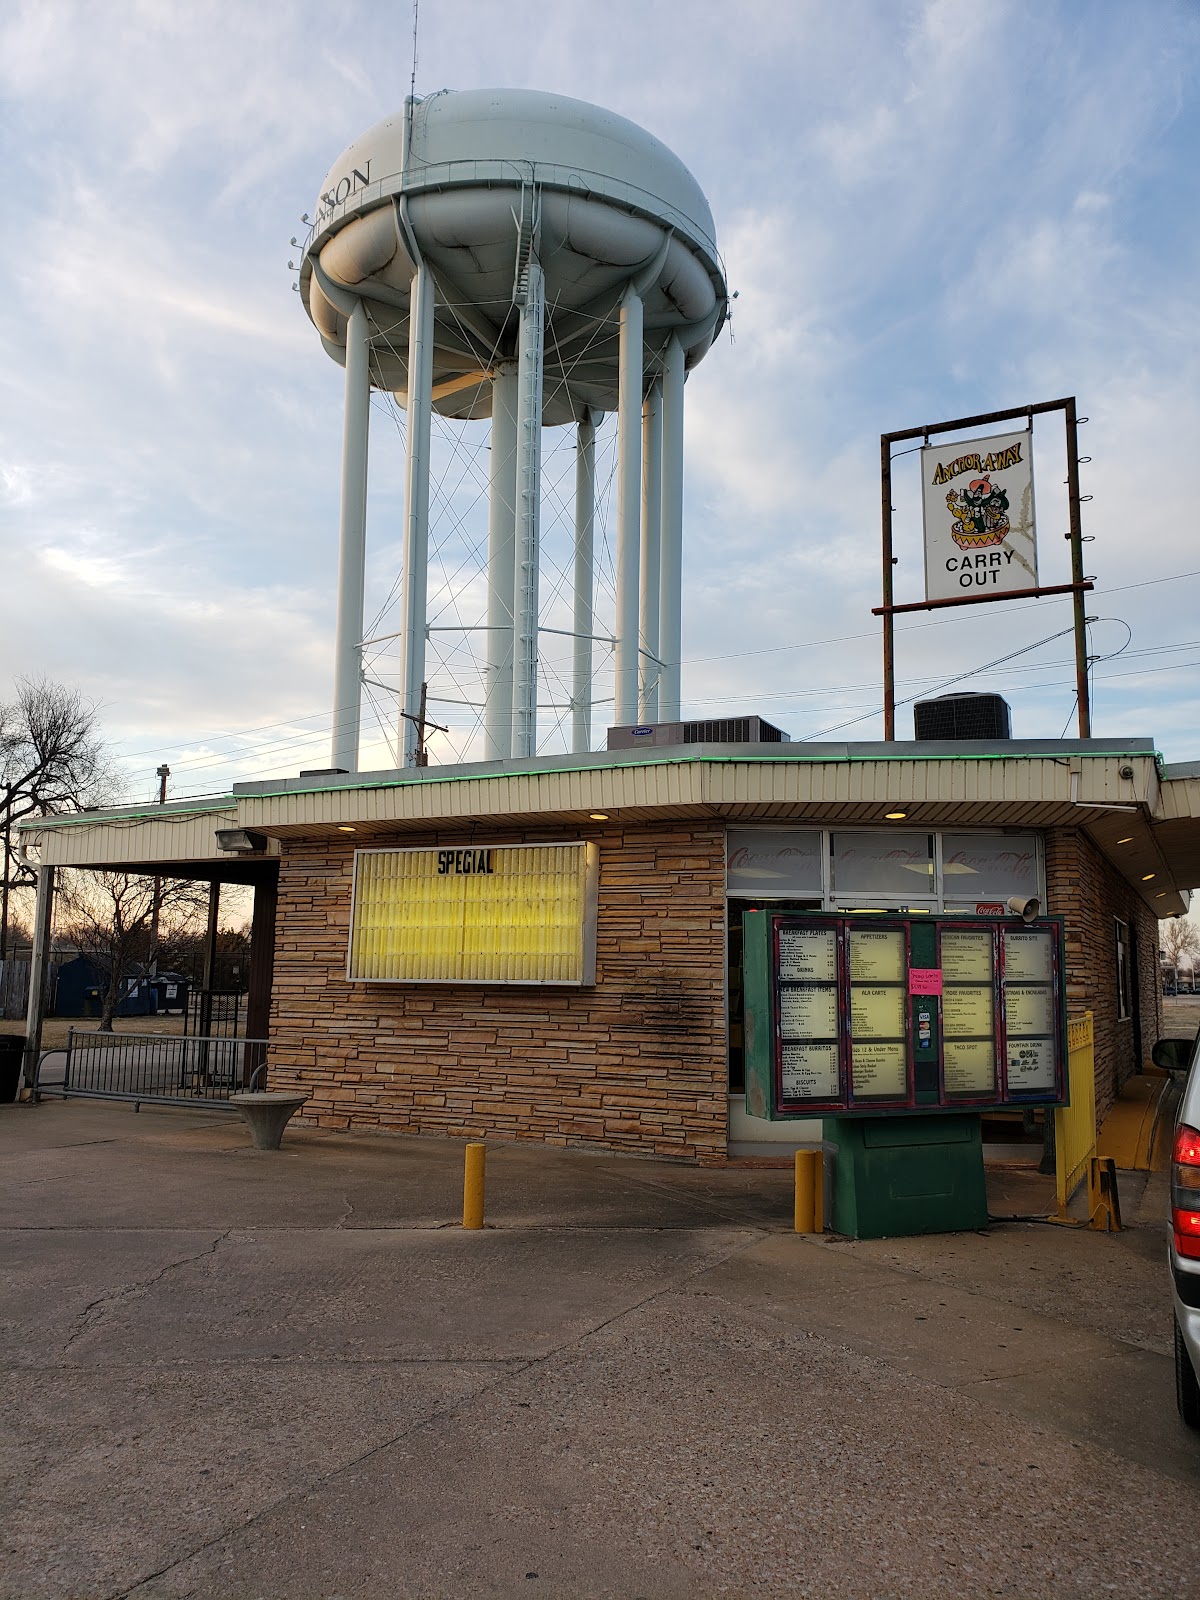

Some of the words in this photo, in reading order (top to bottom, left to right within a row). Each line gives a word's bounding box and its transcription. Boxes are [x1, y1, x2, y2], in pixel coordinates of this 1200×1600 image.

[945, 549, 1015, 571] CARRY
[959, 569, 1000, 587] OUT
[438, 850, 494, 874] SPECIAL
